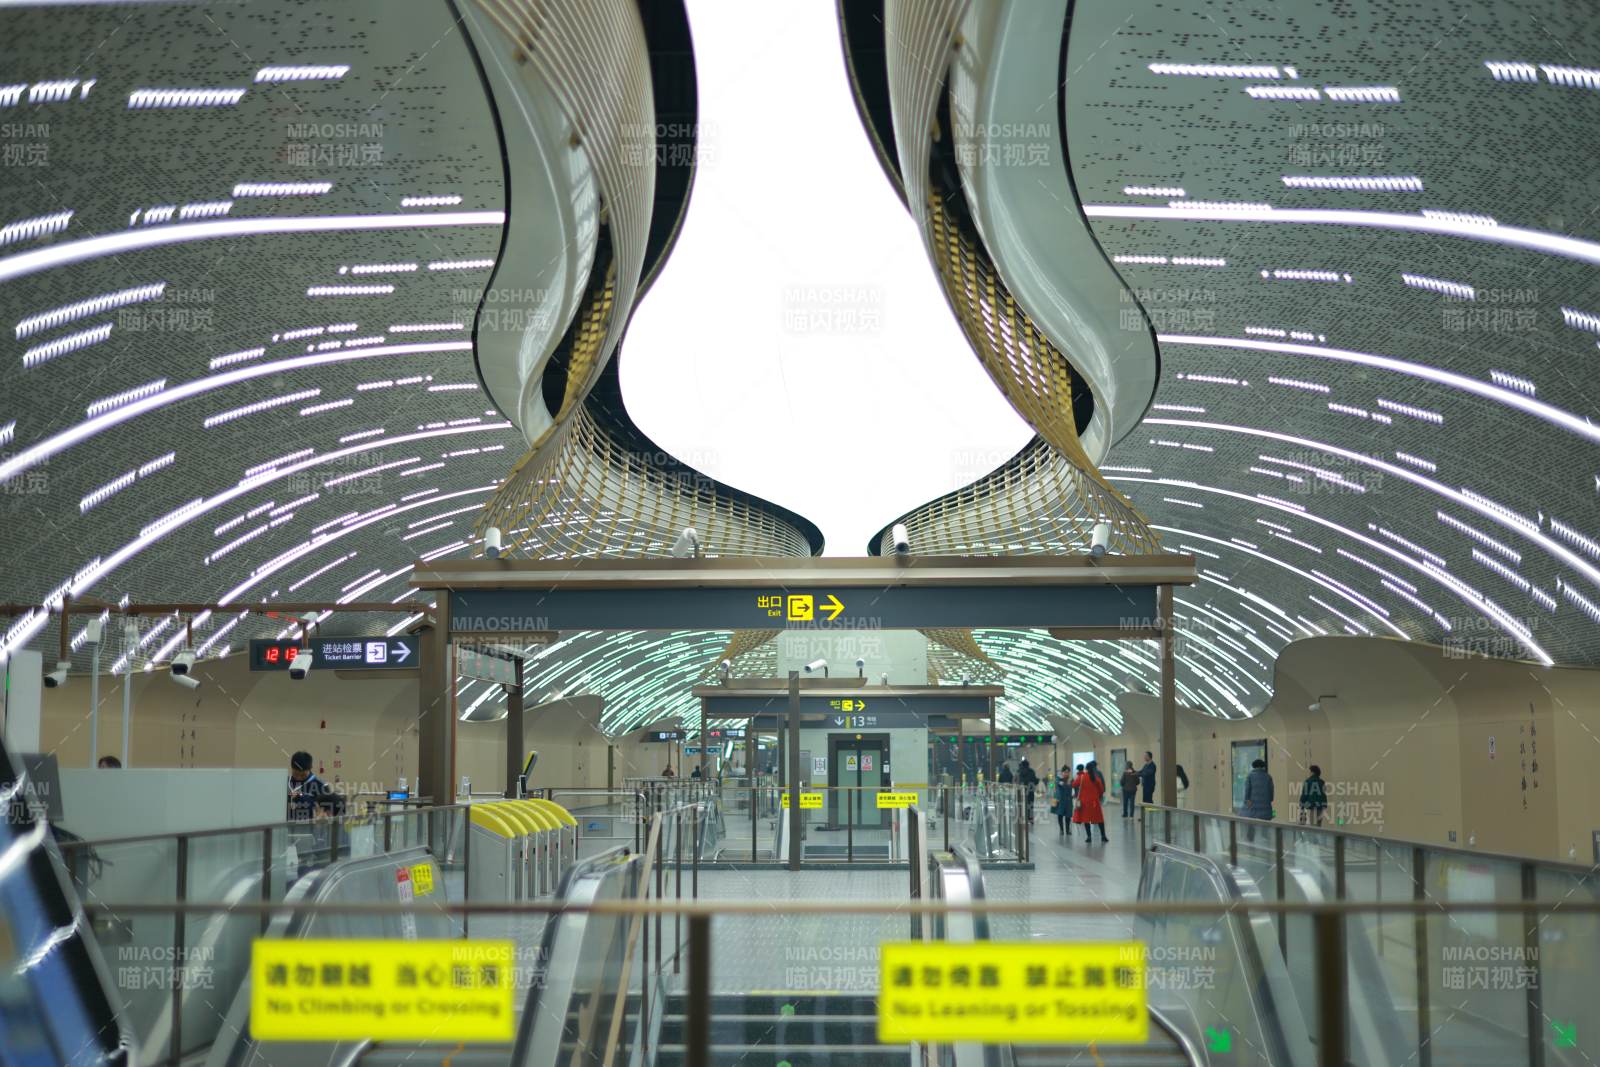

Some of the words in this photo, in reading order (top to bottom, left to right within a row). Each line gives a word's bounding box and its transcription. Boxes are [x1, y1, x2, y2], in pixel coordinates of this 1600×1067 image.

[757, 596, 782, 608] 出口
[767, 609, 782, 617] Exit
[322, 642, 363, 653] 进站检票
[264, 647, 280, 661] 12
[851, 715, 865, 727] 13
[266, 999, 292, 1015] No
[299, 998, 385, 1020] Climbing
[392, 1001, 409, 1015] or
[892, 1002, 922, 1016] No
[928, 1000, 1018, 1021] Leaning
[1024, 1003, 1046, 1017] or
[1054, 999, 1137, 1022] Tossing
